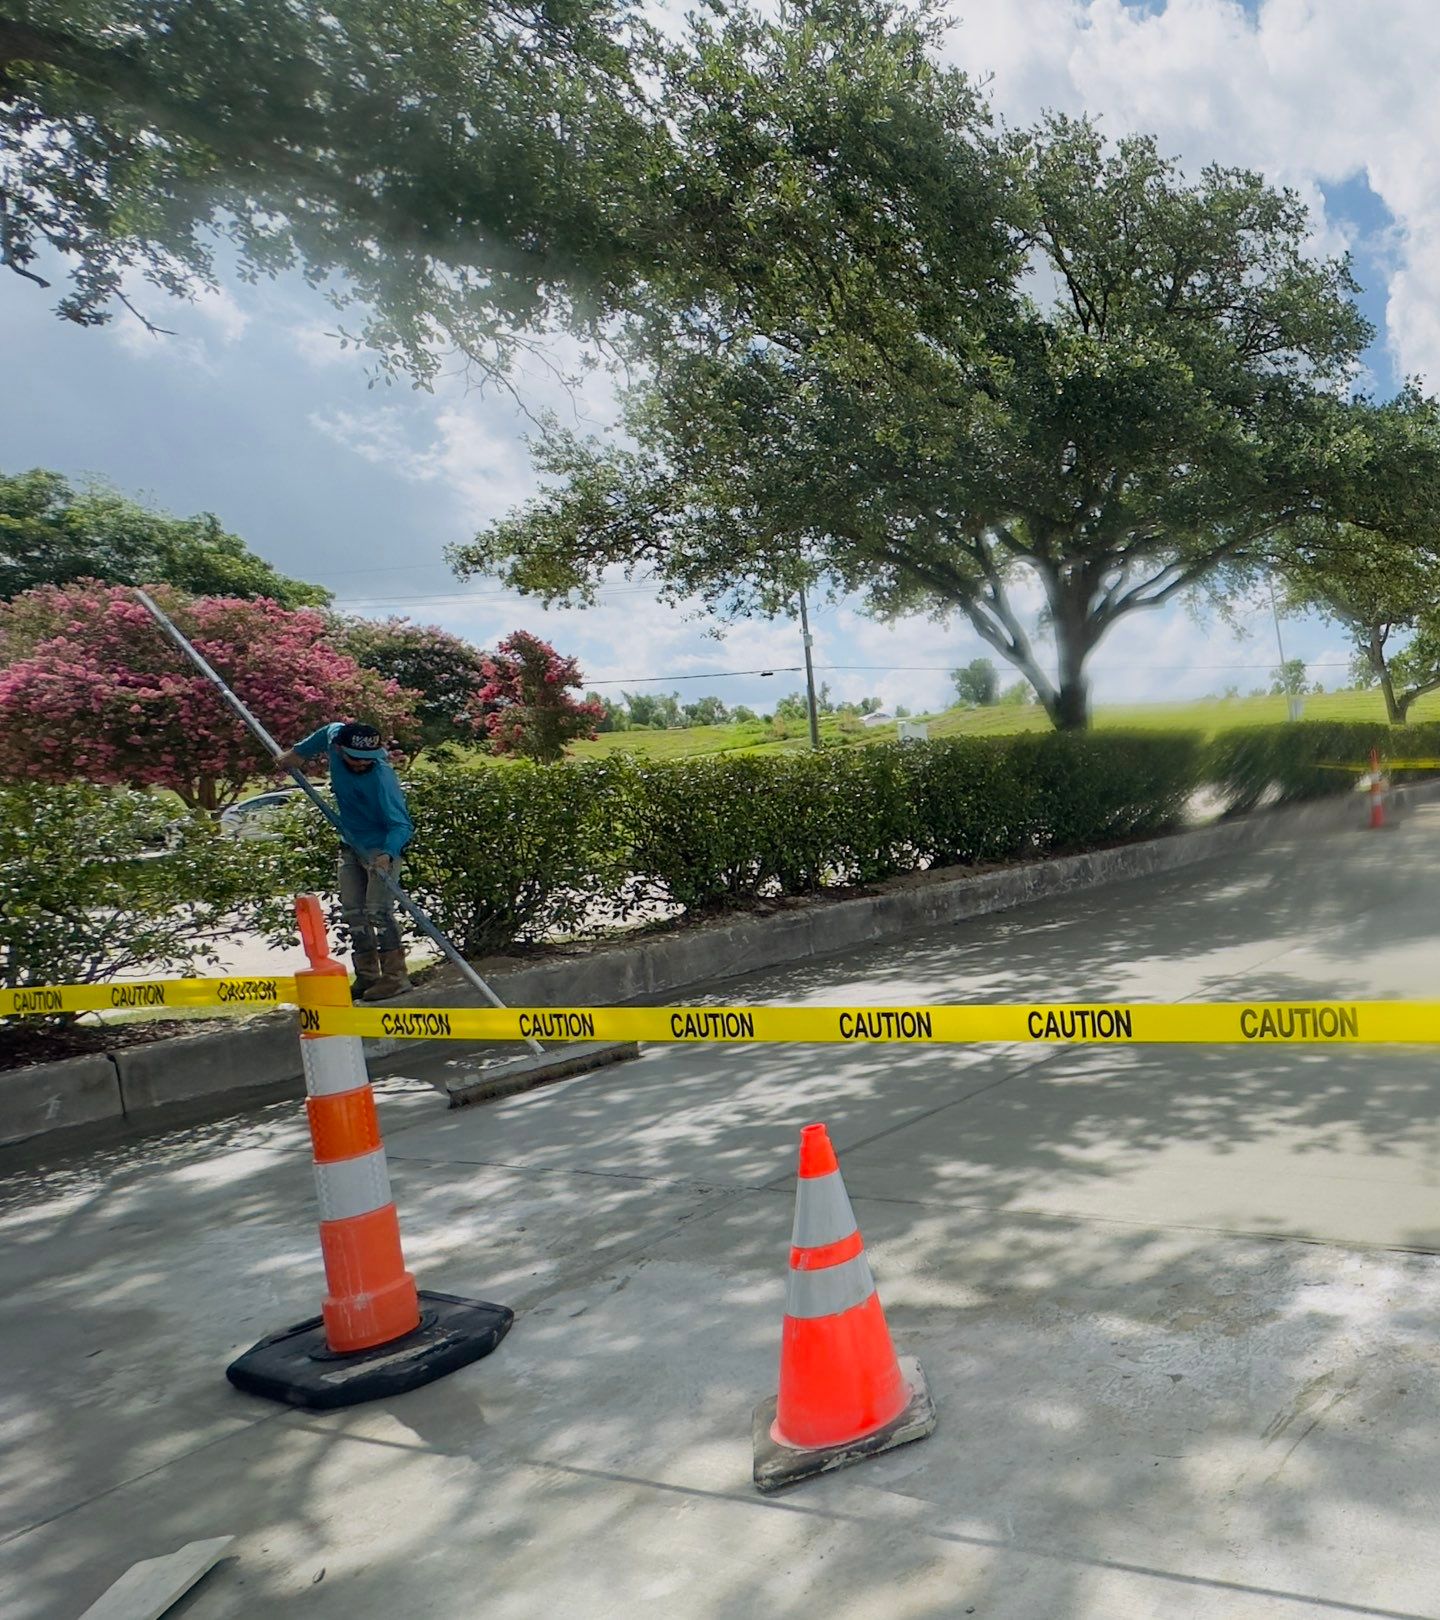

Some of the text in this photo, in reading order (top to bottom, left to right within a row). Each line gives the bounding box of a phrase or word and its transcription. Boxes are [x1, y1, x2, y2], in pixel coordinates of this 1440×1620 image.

[13, 980, 277, 1012] CAUTION CAUTION CAUTION
[381, 1013, 451, 1036] CAUTION
[519, 1013, 594, 1037] CAUTION
[671, 1013, 754, 1038] CAUTION
[840, 1012, 932, 1038] CAUTION
[1028, 1011, 1132, 1038] CAUTION
[1240, 1007, 1359, 1038] CAUTION
